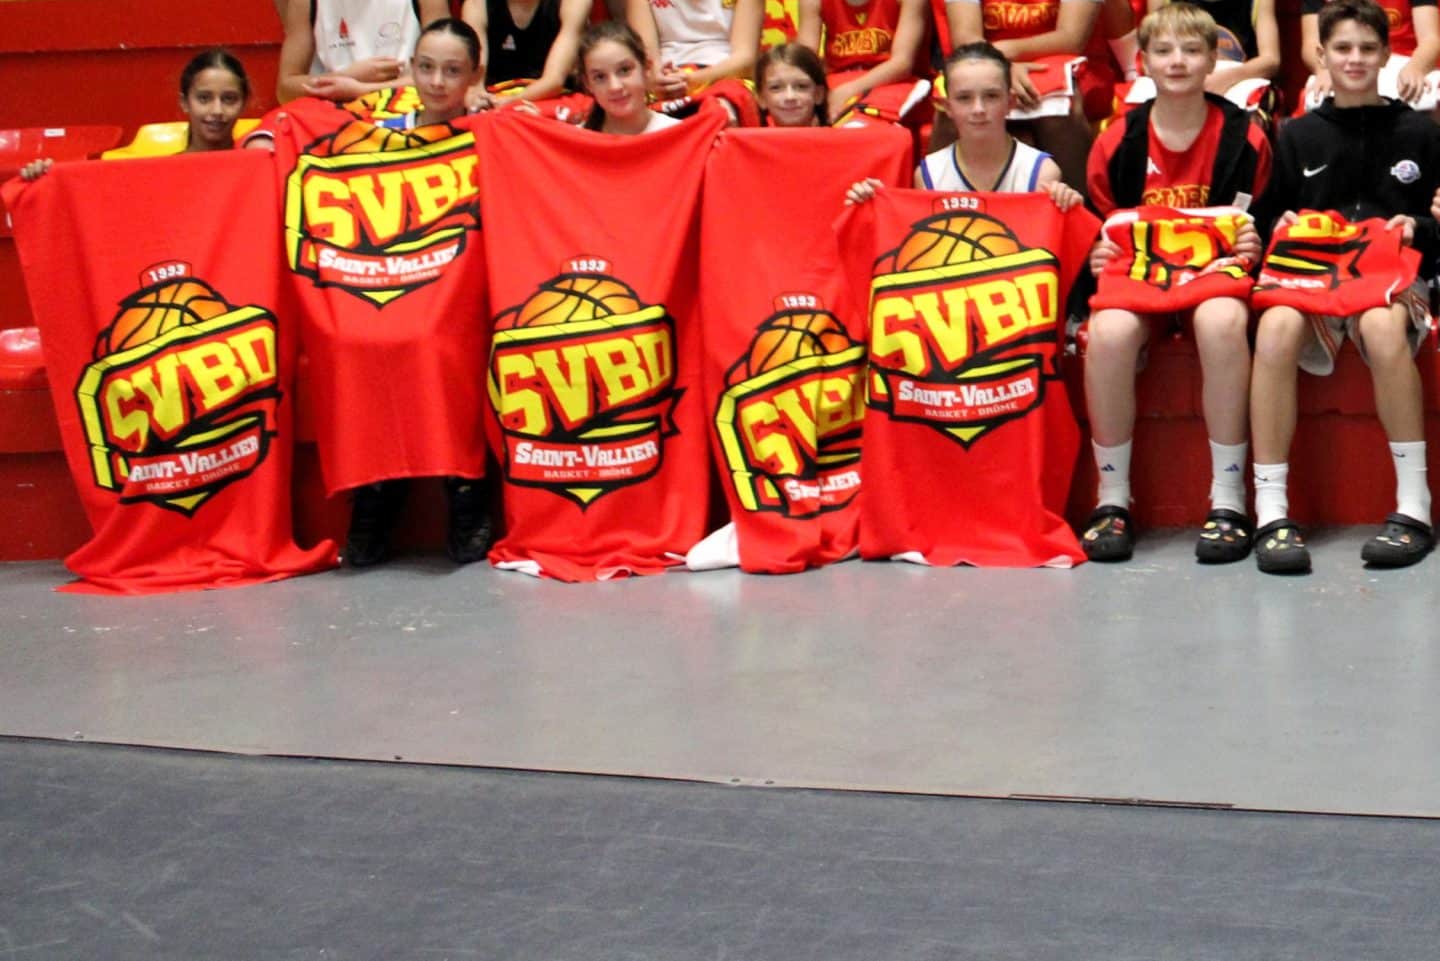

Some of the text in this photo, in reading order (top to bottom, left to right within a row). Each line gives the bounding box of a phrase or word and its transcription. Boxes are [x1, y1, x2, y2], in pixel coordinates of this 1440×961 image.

[872, 271, 1058, 376] SVBD
[106, 326, 277, 453] SVBD
[498, 329, 672, 437] SVBD
[129, 435, 260, 483] AINT-VALLIER
